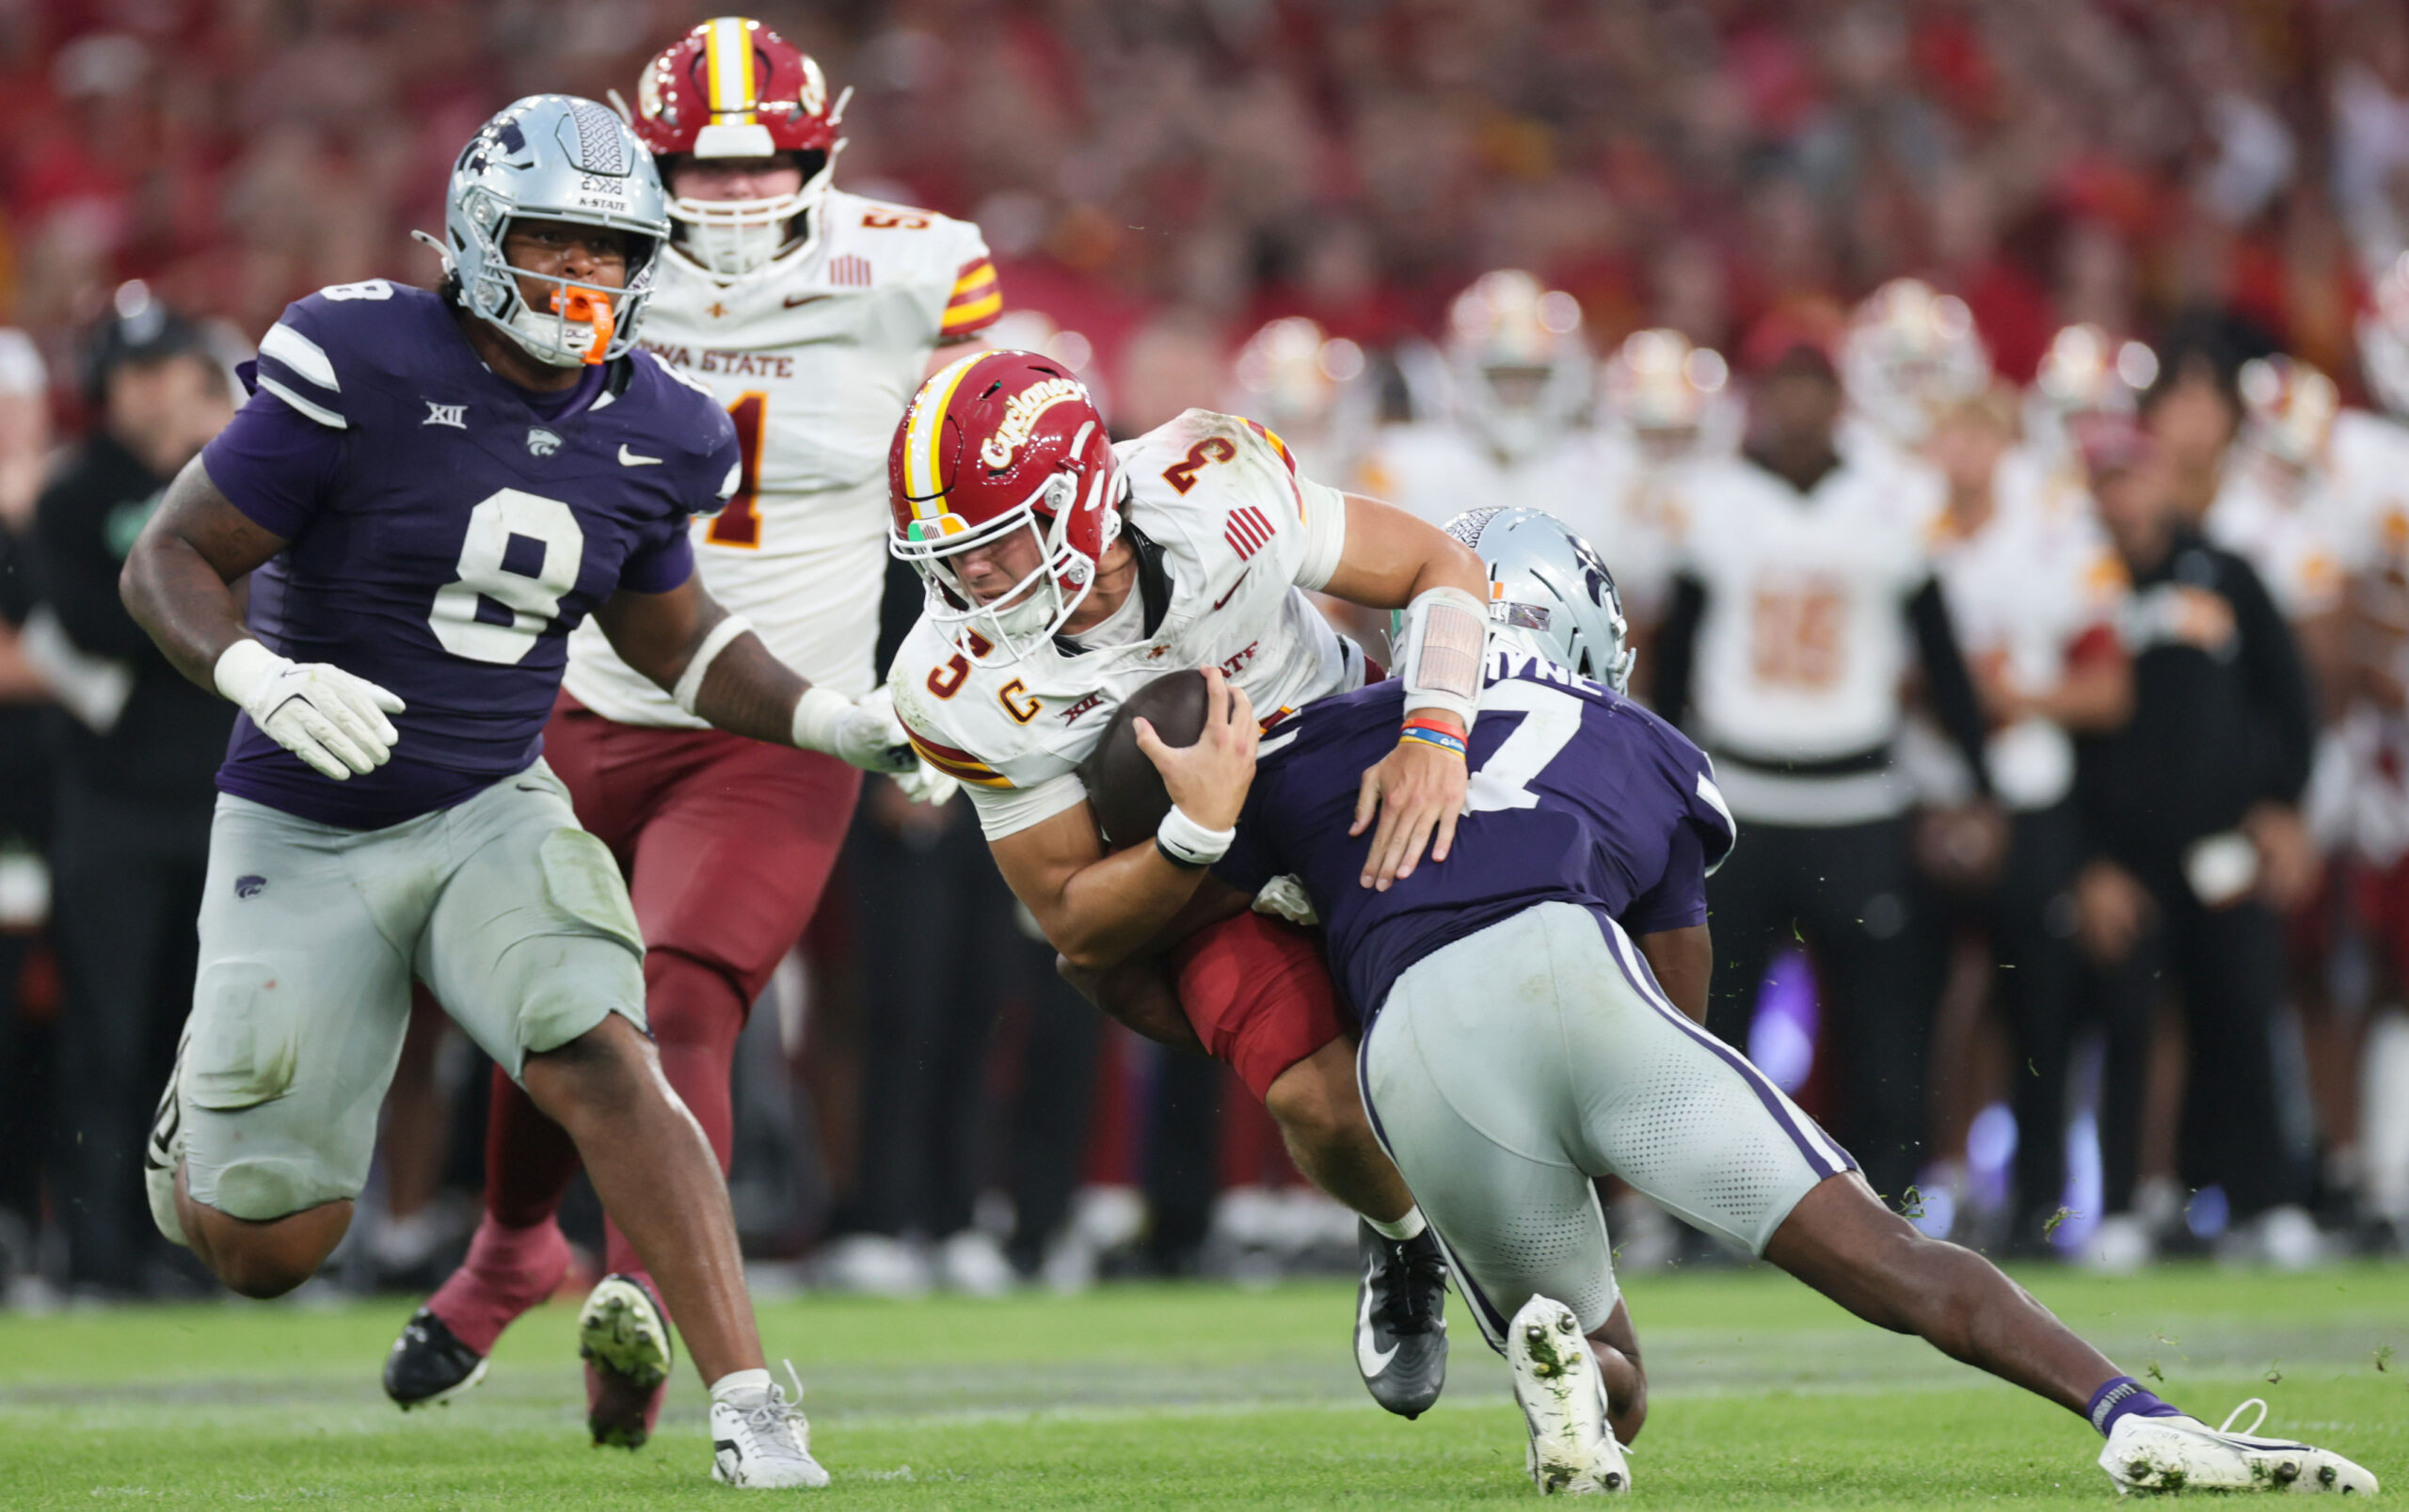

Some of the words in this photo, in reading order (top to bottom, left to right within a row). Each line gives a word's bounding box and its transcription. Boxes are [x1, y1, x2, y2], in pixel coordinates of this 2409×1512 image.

[580, 197, 628, 212] K-STATE
[320, 279, 394, 301] 8
[701, 349, 794, 378] STATE
[423, 400, 469, 430] XII
[981, 377, 1082, 469] Cyclones
[700, 390, 769, 549] 1
[1160, 437, 1237, 497] 3
[427, 486, 584, 665] 8
[927, 625, 995, 701] 3
[998, 677, 1043, 725] C
[1060, 689, 1105, 727] XII
